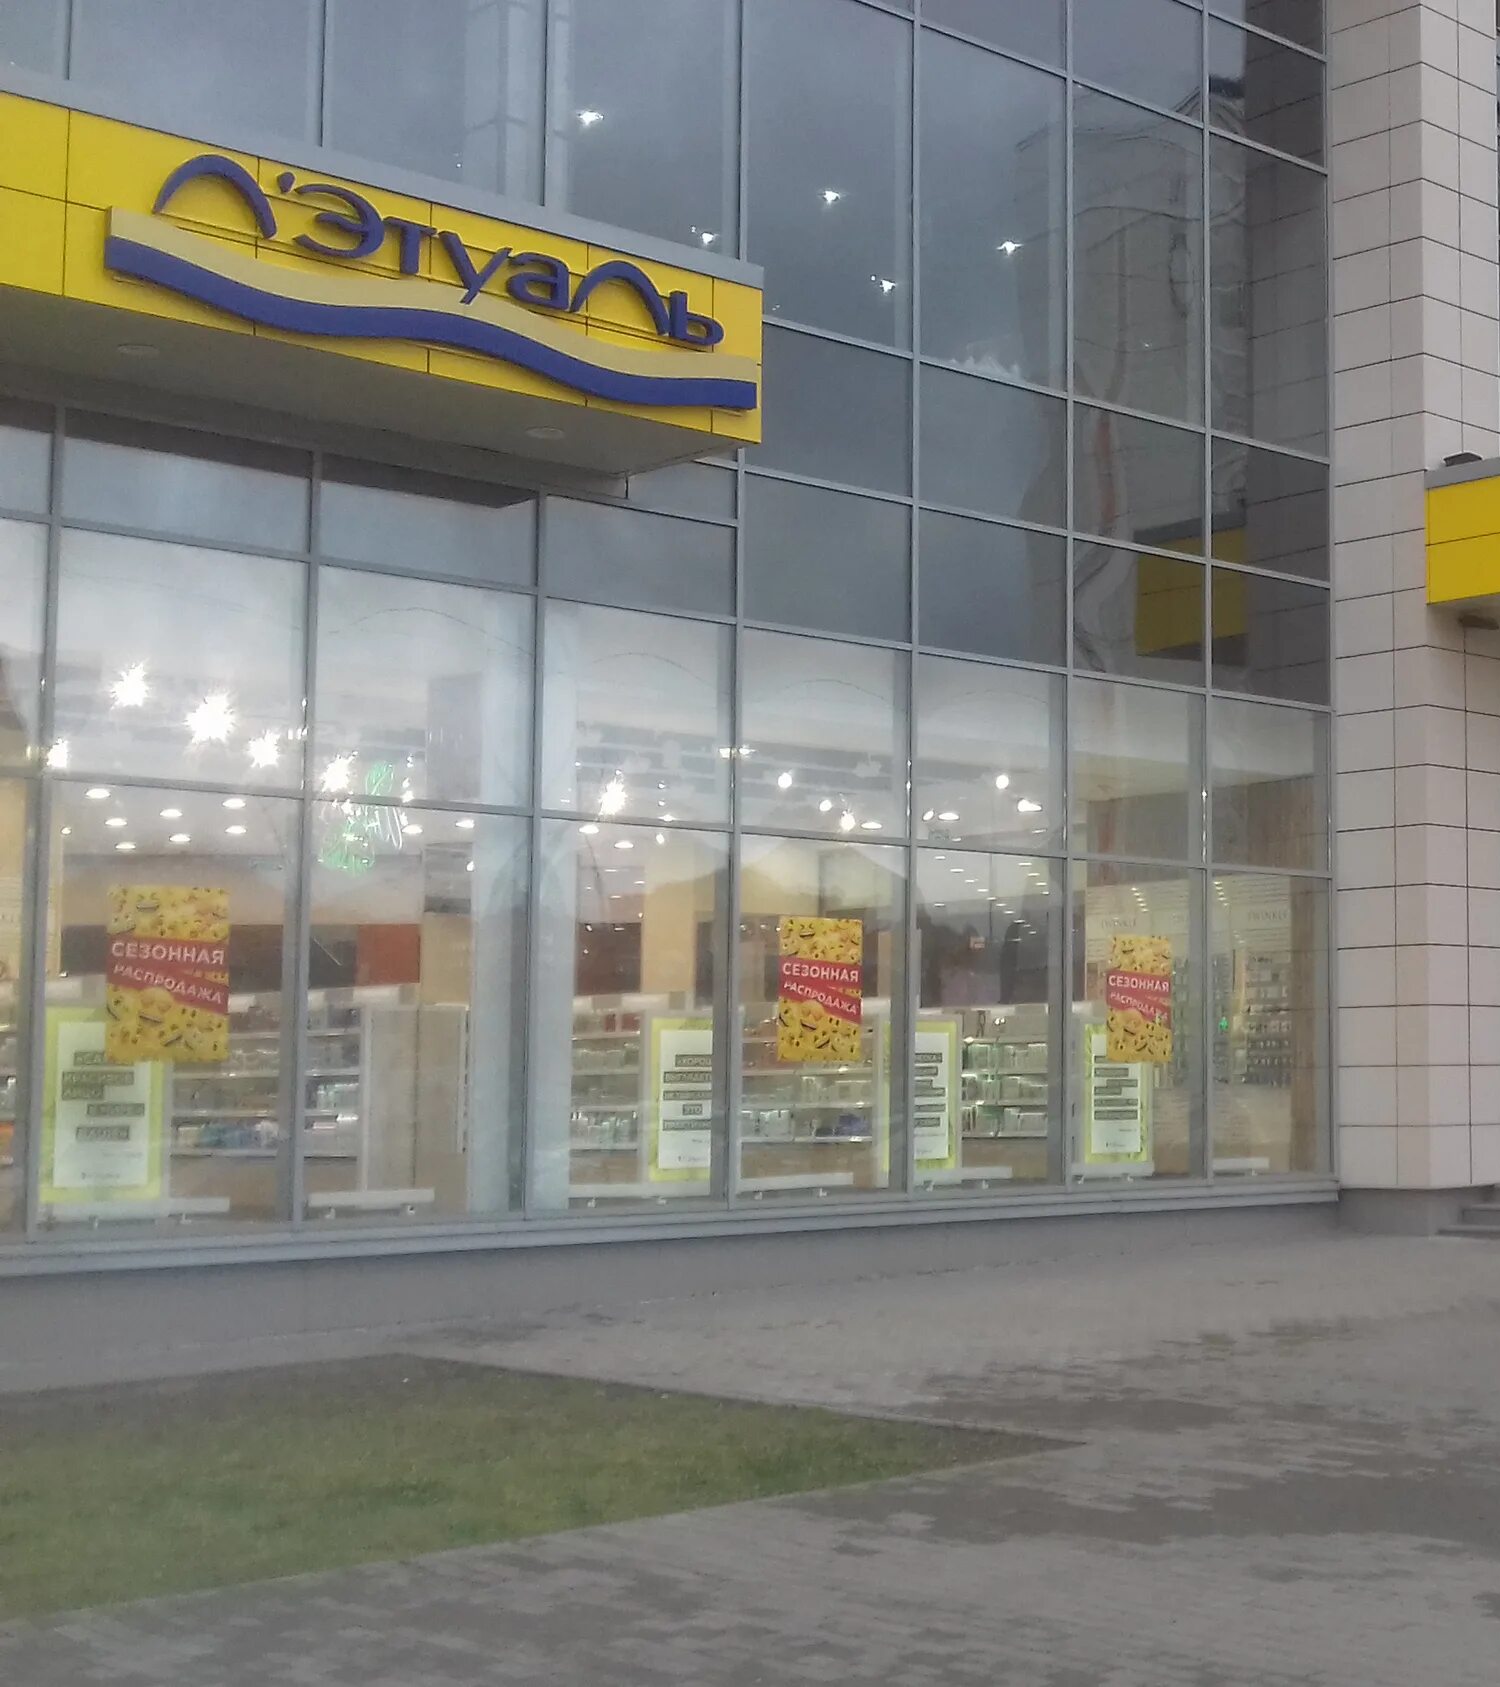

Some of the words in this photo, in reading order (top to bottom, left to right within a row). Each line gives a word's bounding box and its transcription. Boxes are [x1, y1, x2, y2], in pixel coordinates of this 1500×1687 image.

[111, 941, 225, 965] СЕЗОННАЯ
[782, 962, 859, 983] СЕЗОННАЯ
[1108, 975, 1170, 993] СЕЗОННАЯ
[783, 981, 857, 1015] РАСПРОДАЖА
